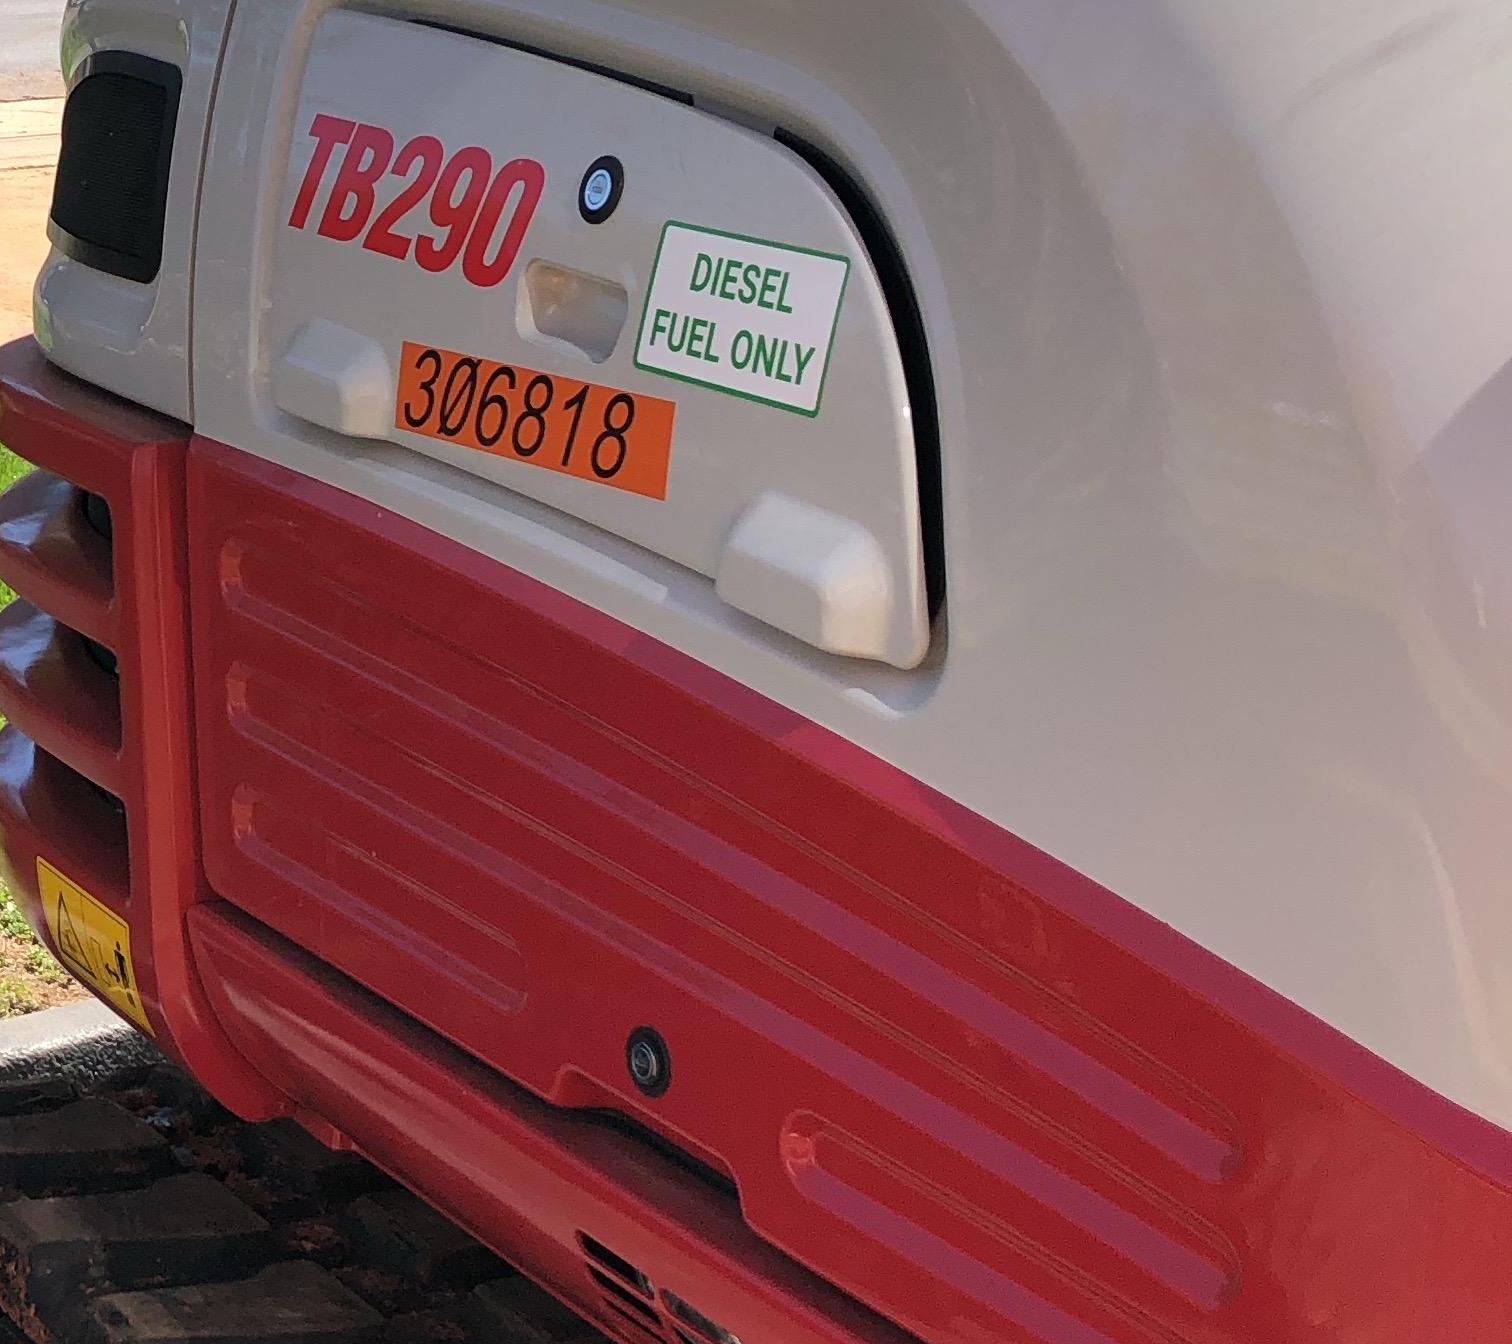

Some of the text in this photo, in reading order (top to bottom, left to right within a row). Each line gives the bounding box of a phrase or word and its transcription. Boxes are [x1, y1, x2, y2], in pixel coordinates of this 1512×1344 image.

[289, 113, 546, 288] TB290
[689, 253, 793, 314] DIESEL
[649, 309, 816, 386] FUEL ONLY
[404, 349, 635, 479] 306818
